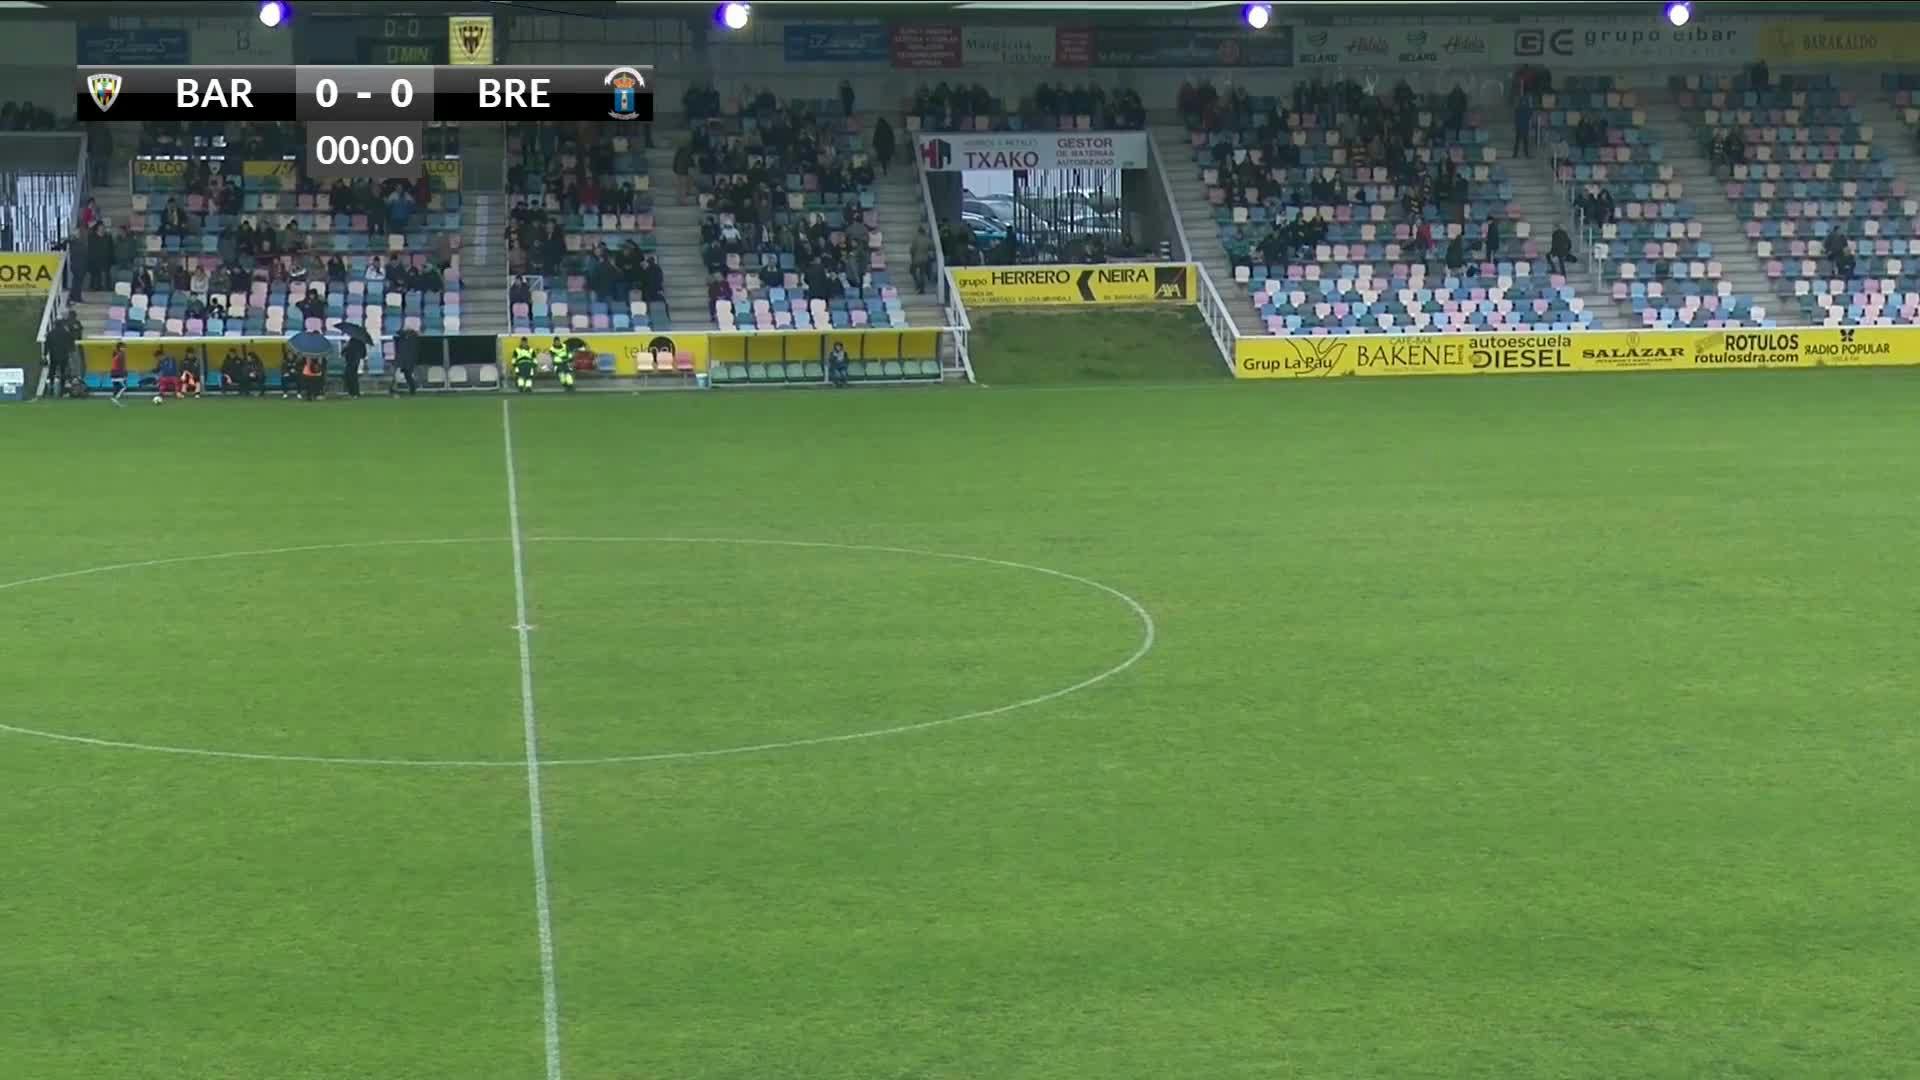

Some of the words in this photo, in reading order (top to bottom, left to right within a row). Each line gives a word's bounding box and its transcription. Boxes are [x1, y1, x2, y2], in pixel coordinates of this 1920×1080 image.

[1584, 28, 1660, 46] grupo
[1673, 26, 1737, 43] eibar
[1803, 33, 1878, 49] BARAKALDO
[1057, 137, 1113, 149] GESTOR
[963, 151, 1040, 169] TXAKO
[1056, 149, 1068, 157] DE
[140, 162, 186, 174] PALCO
[421, 161, 455, 174] ALCO
[0, 264, 52, 283] ORA
[959, 277, 987, 288] grupo
[992, 270, 1070, 285] HERRERO
[1098, 268, 1149, 284] NEIRA
[1155, 283, 1182, 297] AXA
[1469, 335, 1572, 348] autoescuela
[1725, 334, 1799, 351] ROTULOS
[1804, 344, 1839, 355] RADIO
[1842, 342, 1890, 355] POPULAR
[1472, 349, 1571, 368] DIESEL
[1582, 347, 1685, 359] SALAZAR
[1695, 351, 1799, 364] rotulosdra.com
[1243, 357, 1280, 373] Grup
[1285, 357, 1301, 369] La
[1305, 356, 1332, 369] Pau
